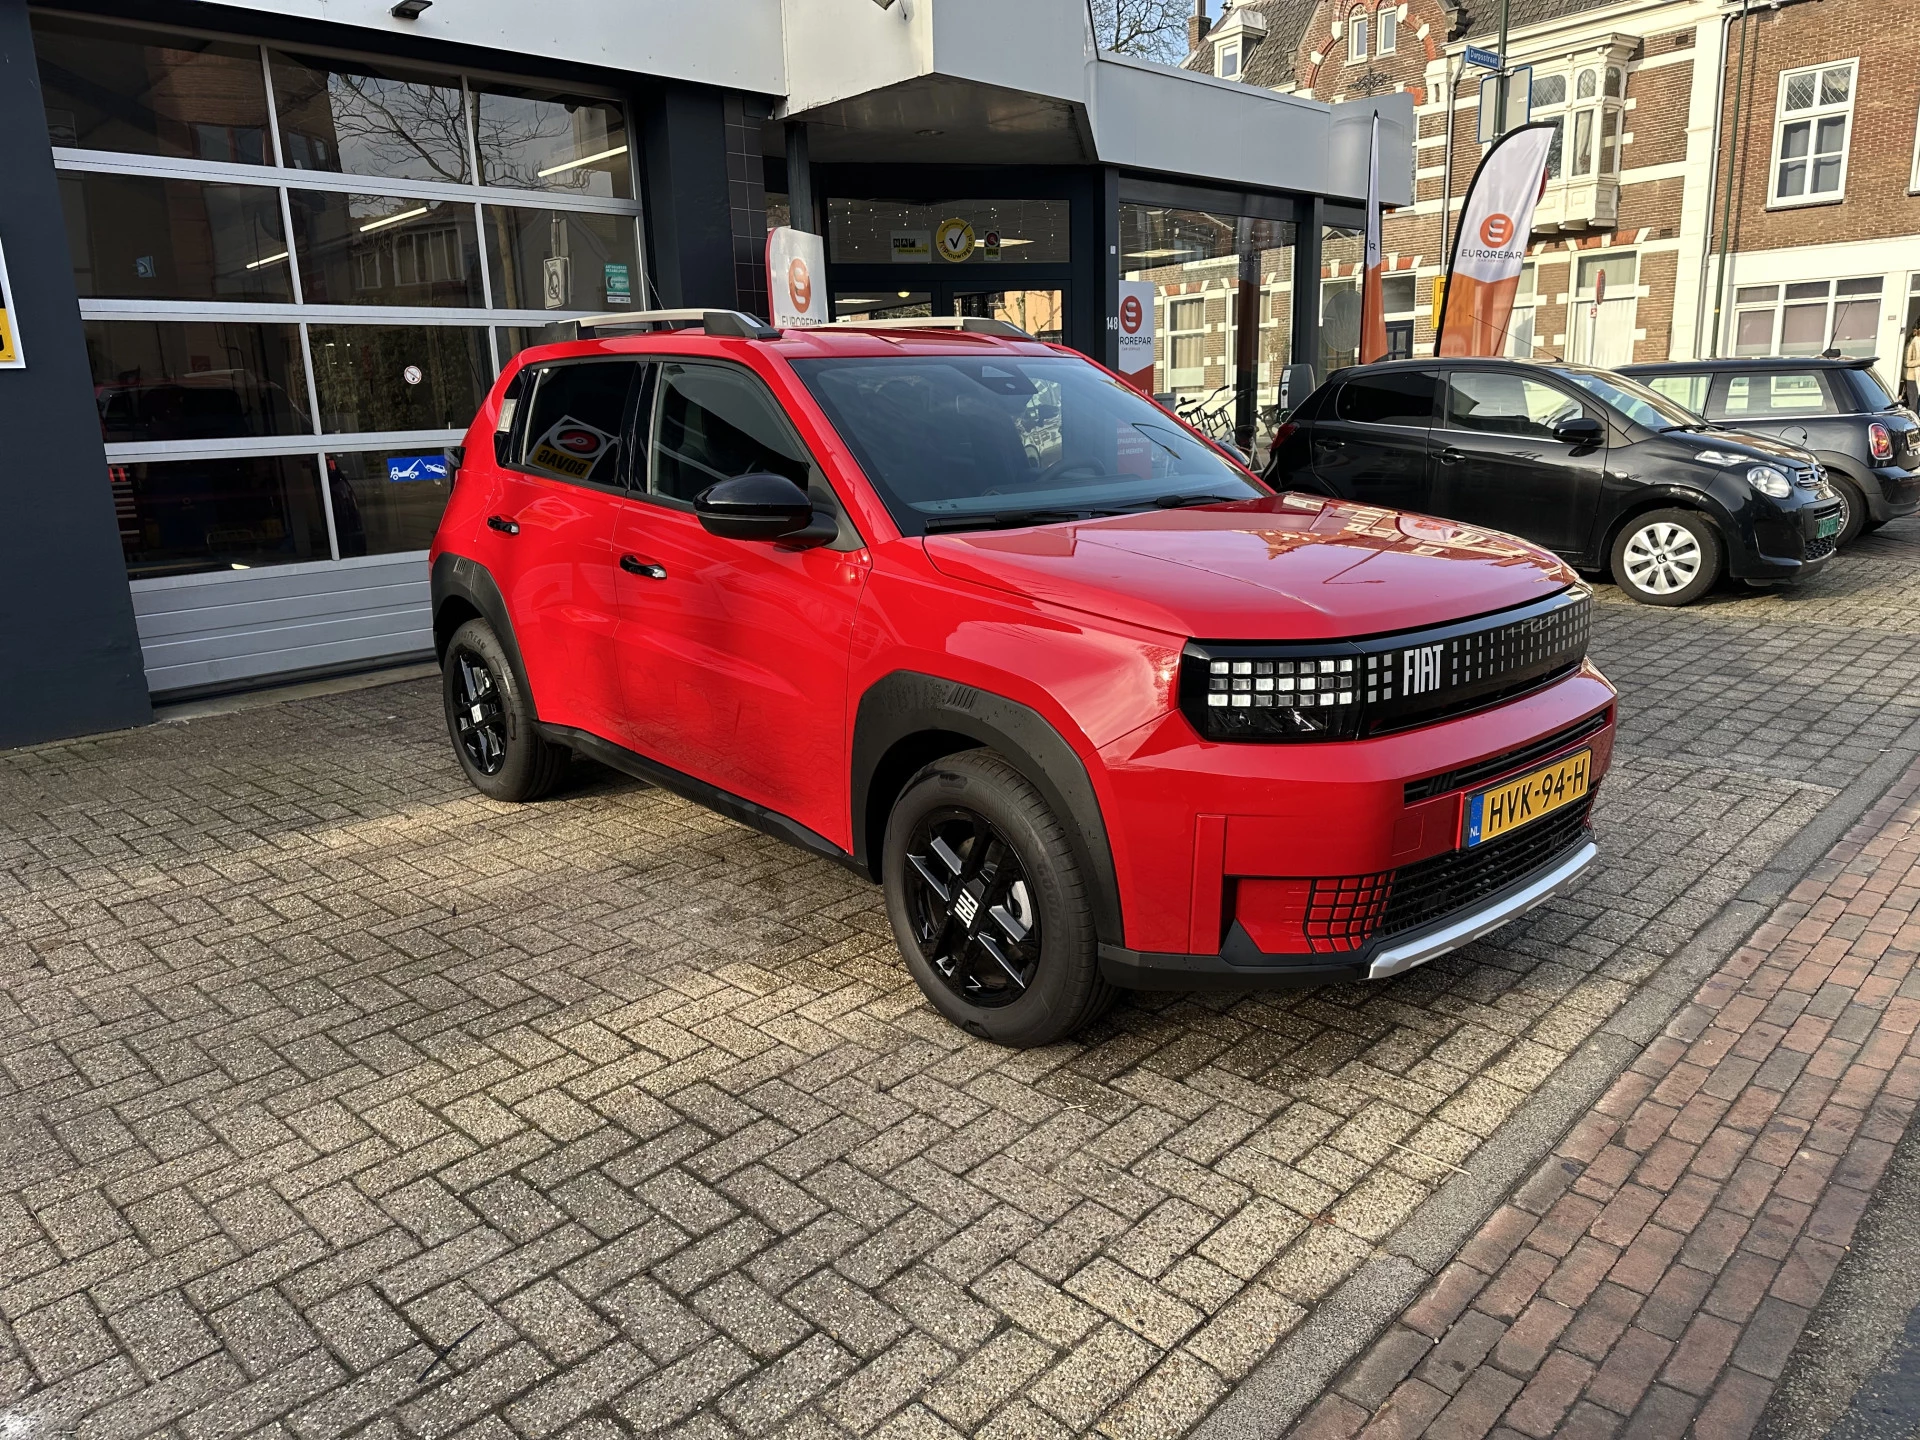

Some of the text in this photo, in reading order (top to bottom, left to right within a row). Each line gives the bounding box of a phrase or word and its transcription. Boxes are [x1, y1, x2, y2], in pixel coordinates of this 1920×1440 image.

[1461, 248, 1523, 259] EUROREPAR
[1106, 316, 1118, 330] 148
[1120, 336, 1152, 345] ROREPAR
[1403, 644, 1444, 696] FIAT
[1488, 758, 1586, 832] HVK-94-H
[1469, 826, 1480, 837] NL
[954, 888, 979, 928] FIAT
